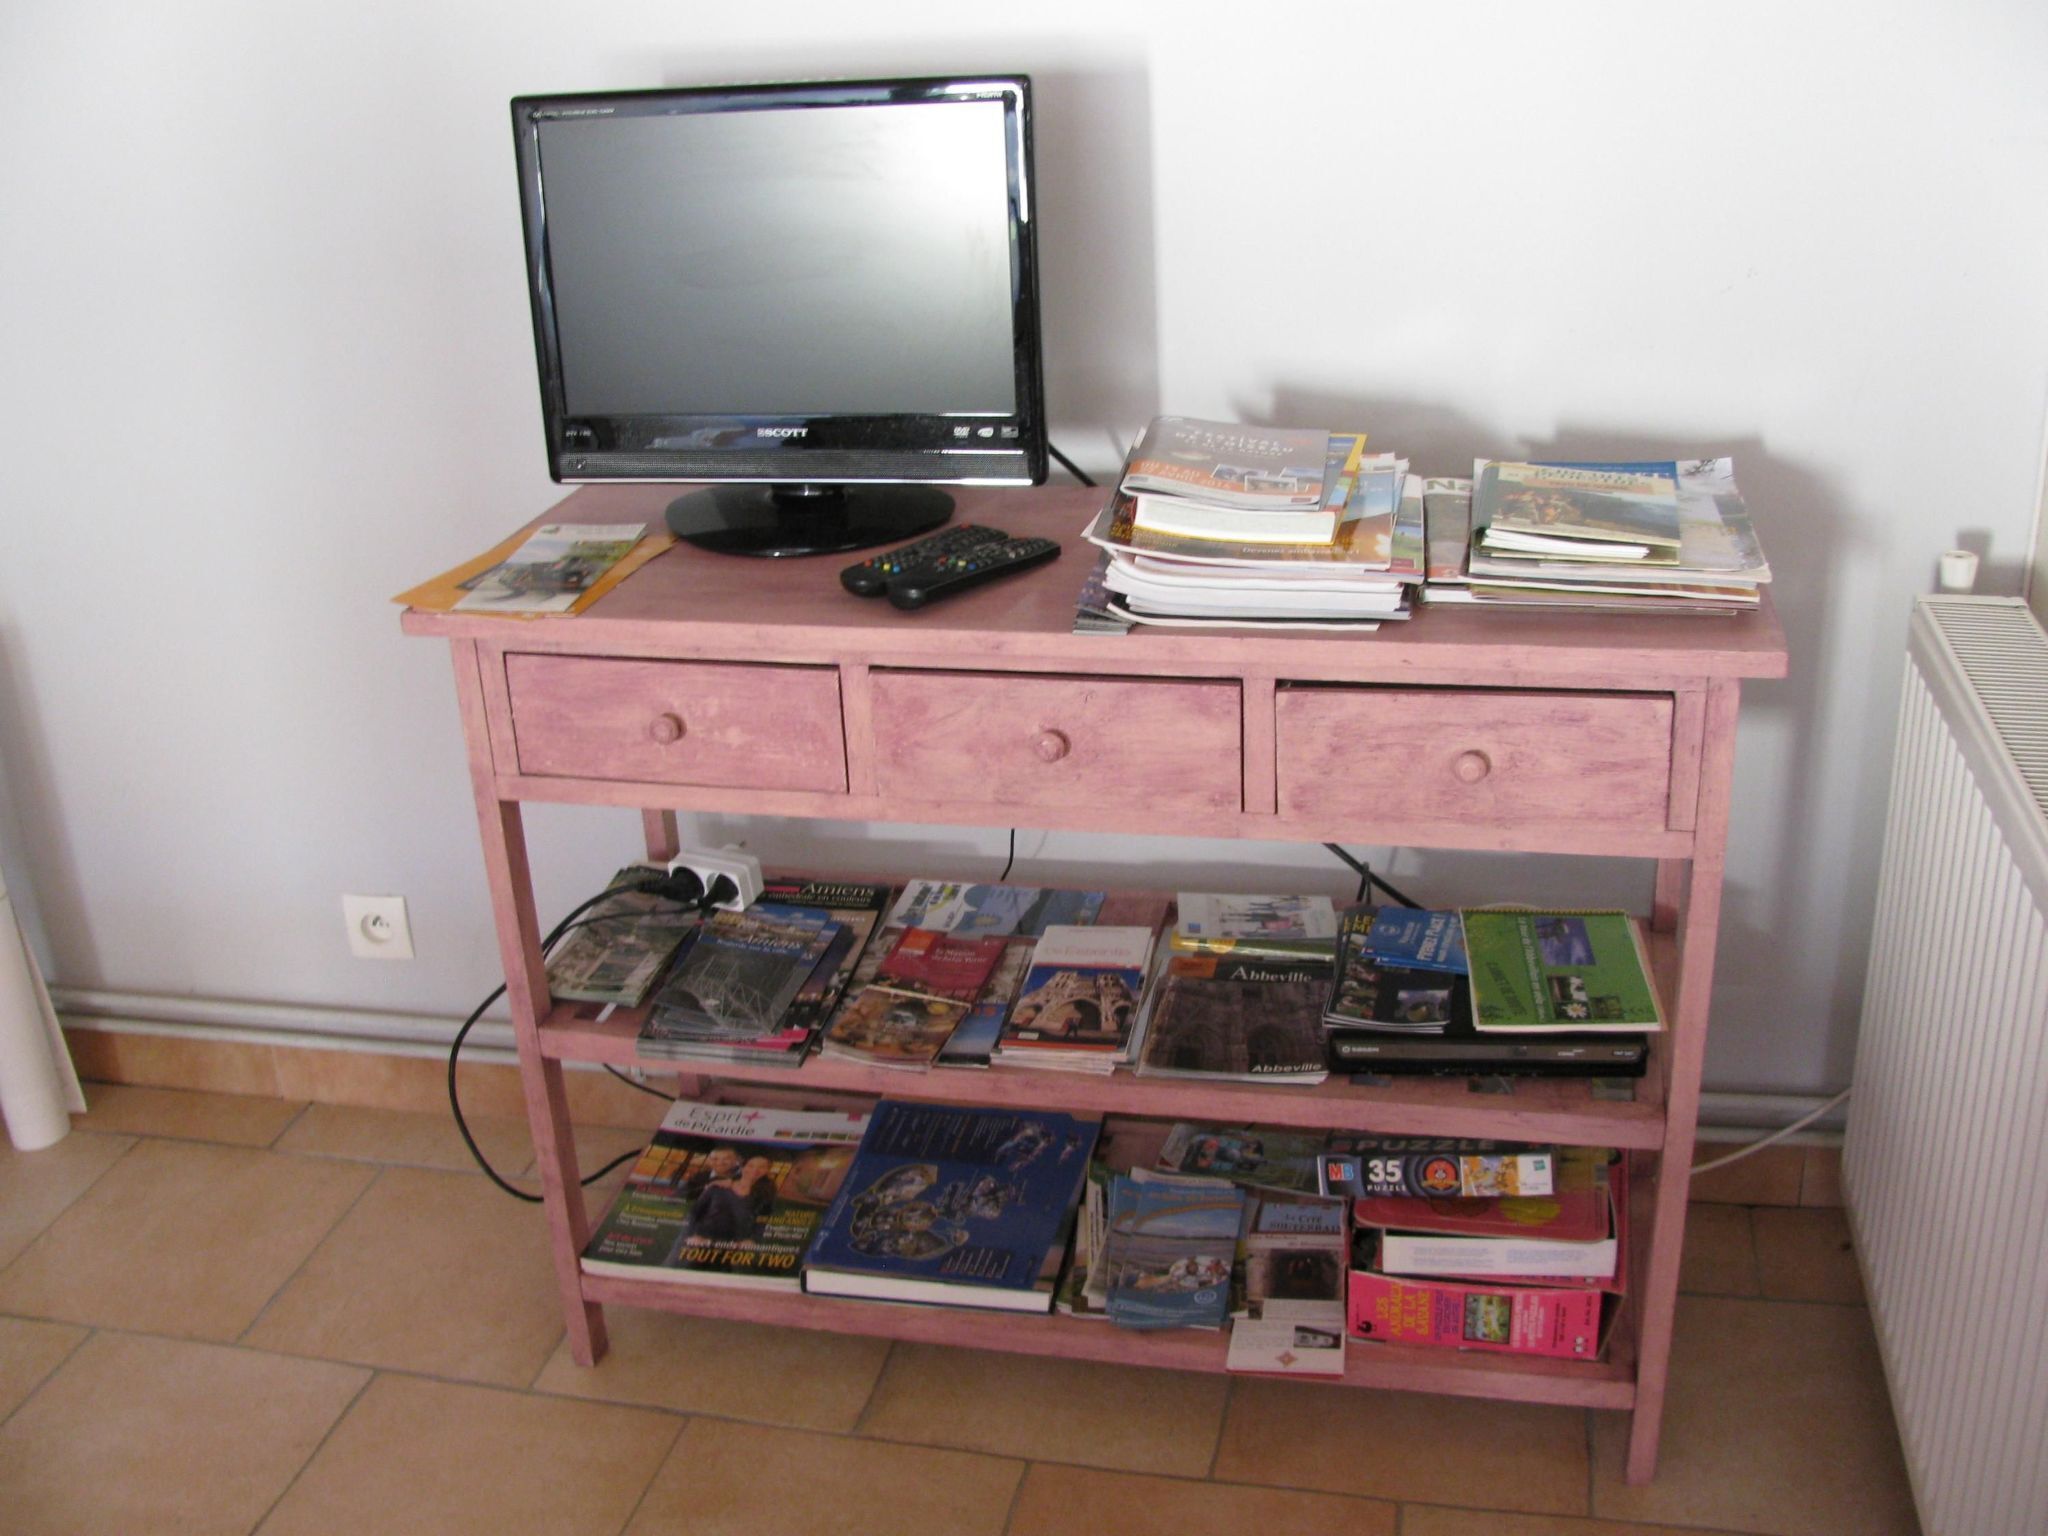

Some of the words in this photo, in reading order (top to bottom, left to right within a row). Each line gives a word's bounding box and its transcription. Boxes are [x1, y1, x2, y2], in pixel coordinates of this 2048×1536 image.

[764, 427, 808, 438] SCOTT
[802, 882, 875, 897] Amiens
[1230, 965, 1313, 983] Abbeville
[1251, 1062, 1322, 1074] Abbeville
[691, 1121, 755, 1137] Picardie
[1357, 1138, 1497, 1151] PUZZLE
[1328, 1163, 1354, 1181] MB
[1368, 1159, 1402, 1183] 35
[1366, 1184, 1407, 1192] PUZZLE
[739, 1240, 801, 1255] romantiques
[678, 1246, 719, 1264] TOUT
[721, 1250, 755, 1266] FOR
[758, 1252, 796, 1269] TWO
